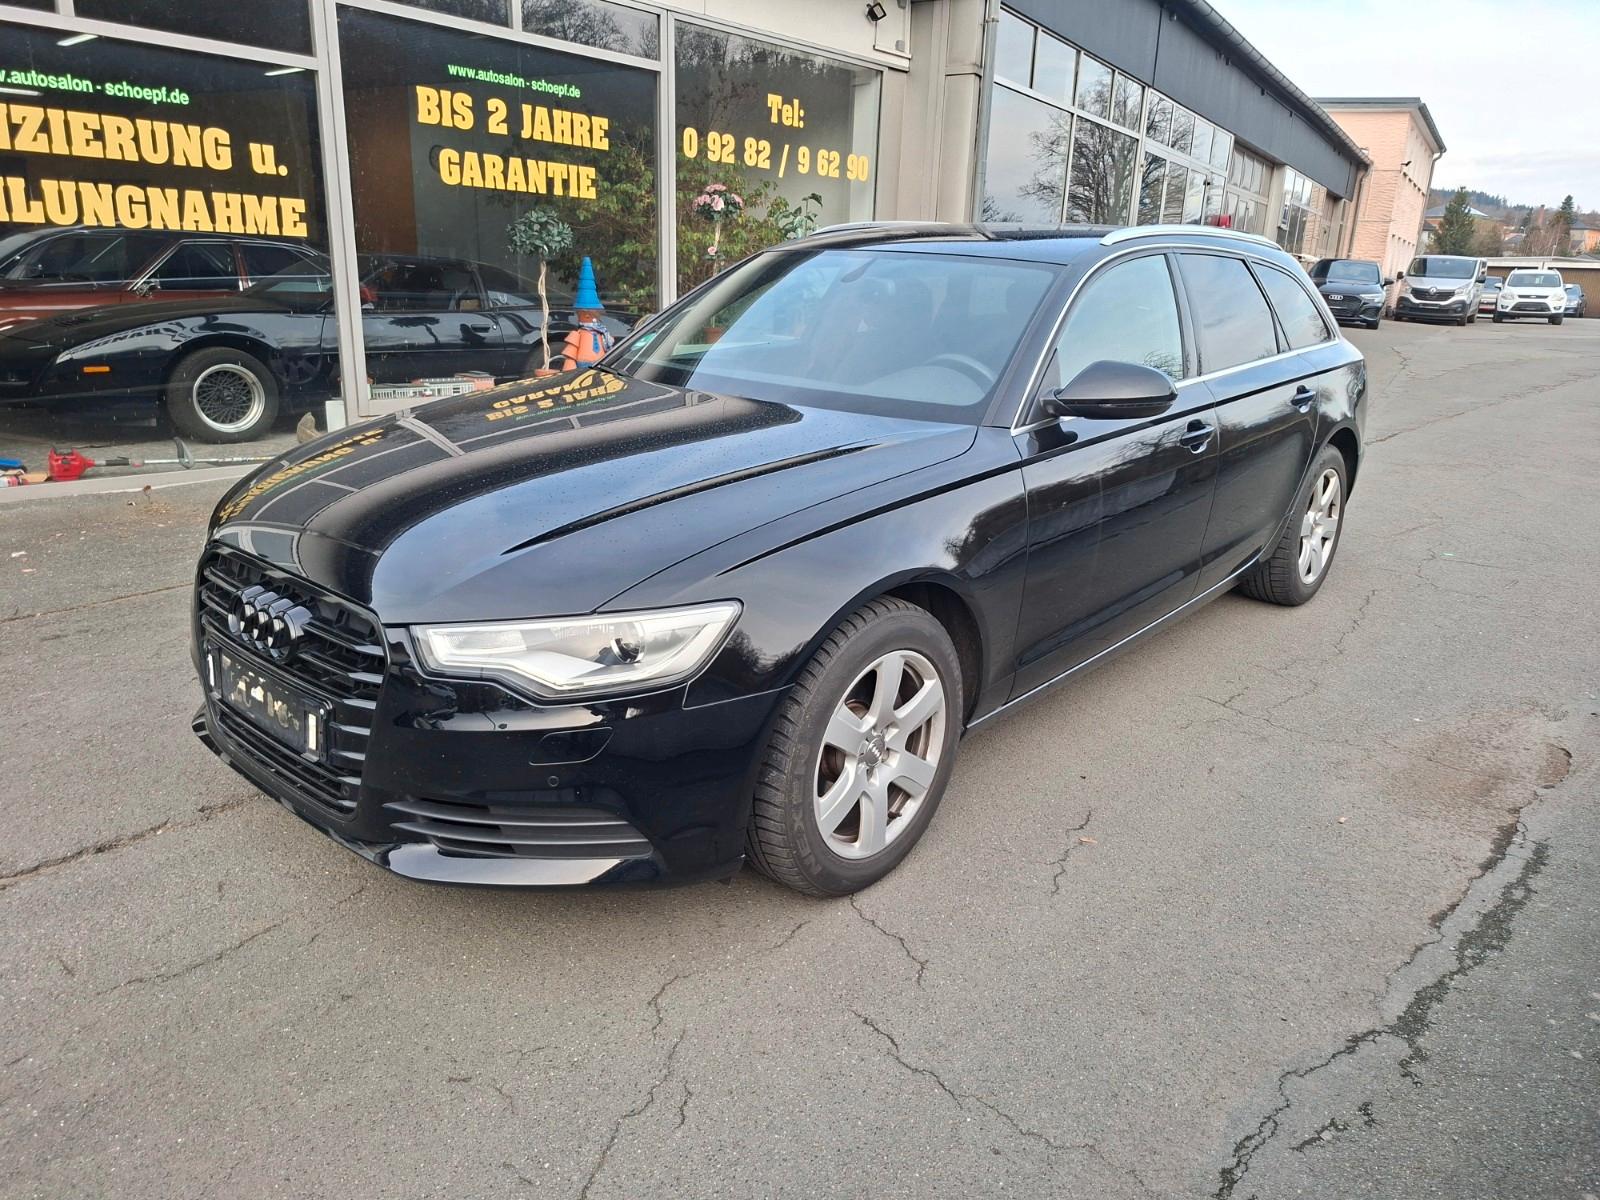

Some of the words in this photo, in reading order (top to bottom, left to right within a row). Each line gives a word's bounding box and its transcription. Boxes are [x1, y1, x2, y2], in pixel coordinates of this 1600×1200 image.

[105, 81, 190, 105] schoepf.de
[448, 64, 525, 88] www.autosalon
[531, 79, 581, 98] schoepf.de
[416, 85, 474, 130] BIS
[487, 98, 508, 135] 2
[521, 104, 609, 150] JAHRE
[767, 93, 805, 128] Tel:
[249, 143, 288, 176] u.
[439, 148, 597, 199] GARANTIE
[683, 127, 698, 158] 0
[707, 131, 736, 164] 92
[744, 137, 771, 169] 82
[778, 144, 790, 178] /
[797, 146, 810, 174] 9
[817, 149, 840, 178] 62
[846, 154, 869, 182] 90
[0, 176, 308, 237] LUNGNAHME
